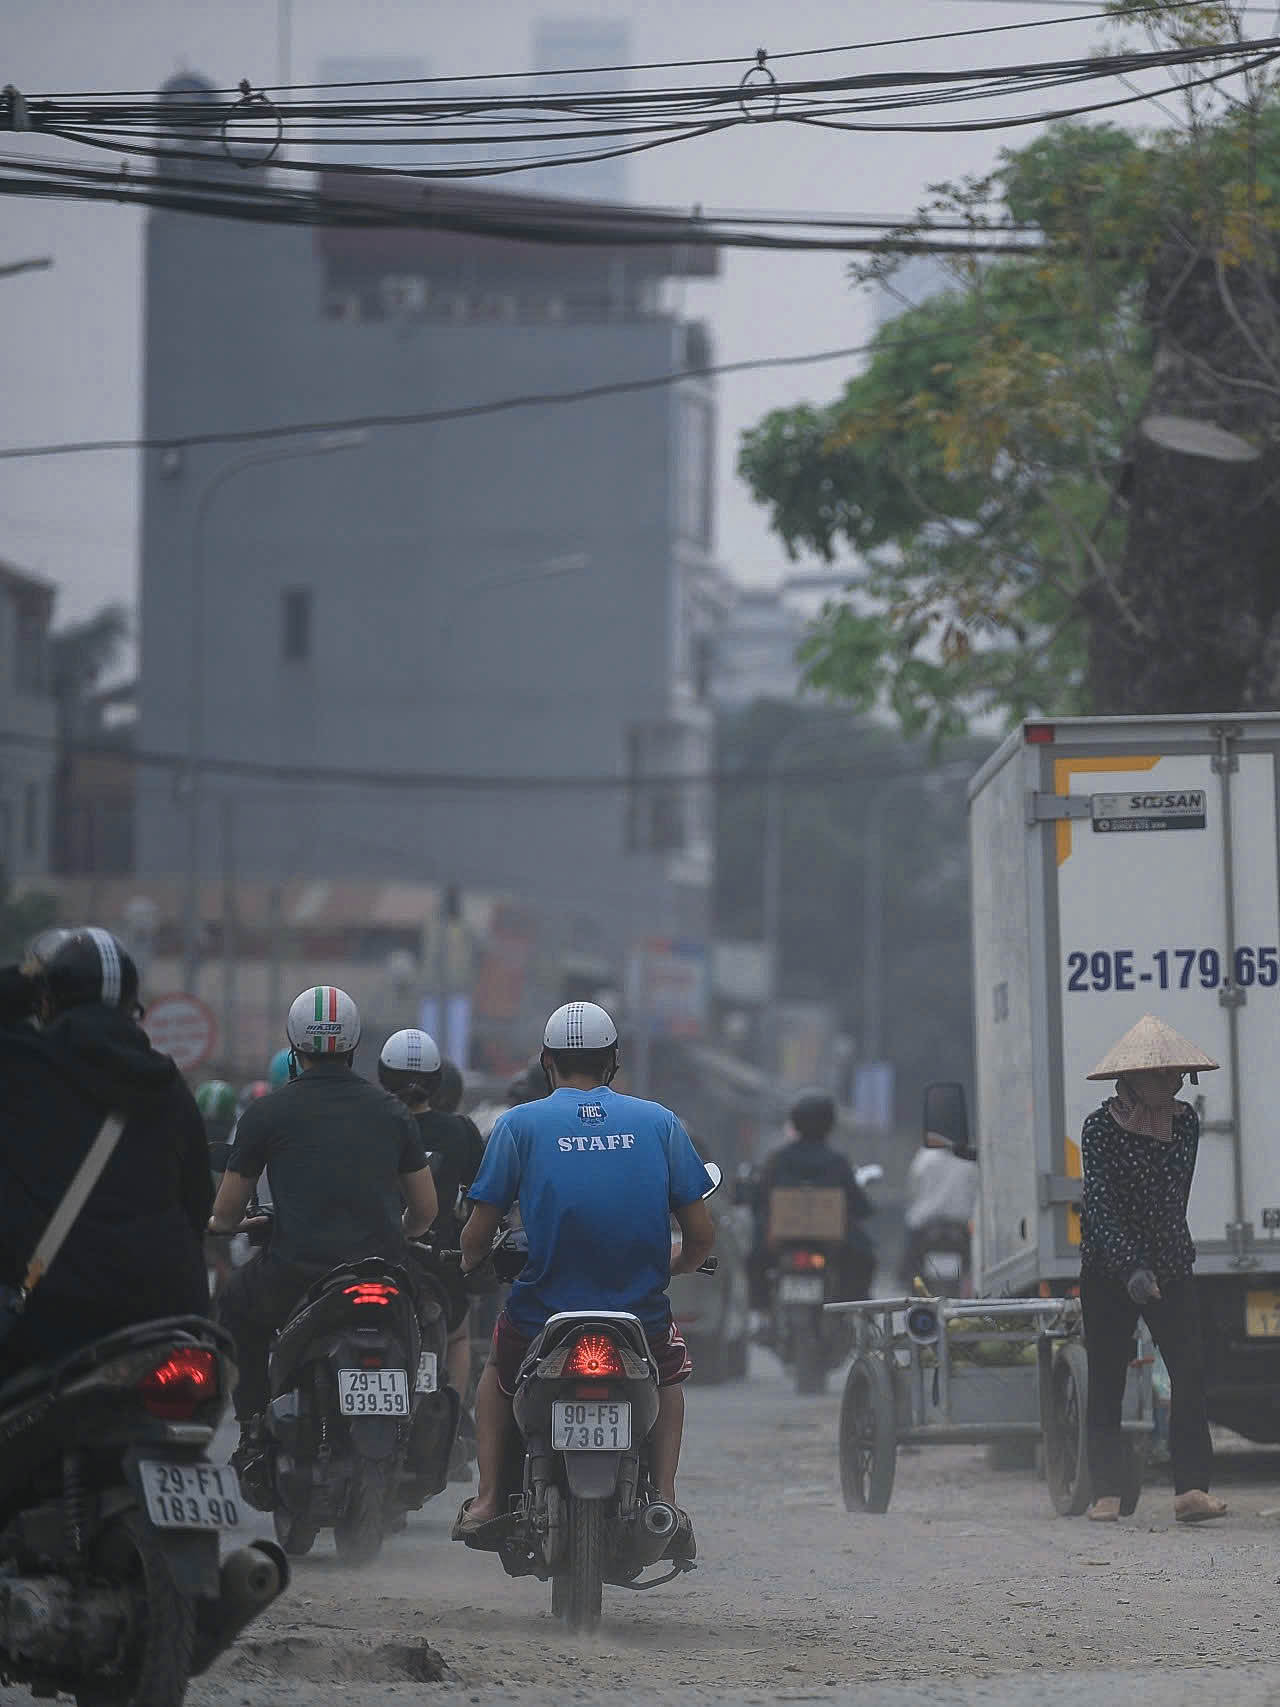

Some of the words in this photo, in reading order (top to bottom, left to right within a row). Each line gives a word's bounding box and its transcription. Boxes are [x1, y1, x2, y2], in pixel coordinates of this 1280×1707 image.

[1067, 947, 1279, 991] 29E-179.65
[582, 1105, 602, 1118] HBC
[557, 1134, 635, 1152] STAFF
[349, 1373, 397, 1392] 29-L1
[344, 1394, 404, 1412] 939.59
[564, 1405, 619, 1425] 90-F5
[564, 1427, 618, 1447] 7361
[156, 1466, 225, 1497] 29-F1
[157, 1496, 239, 1527] 183.90
